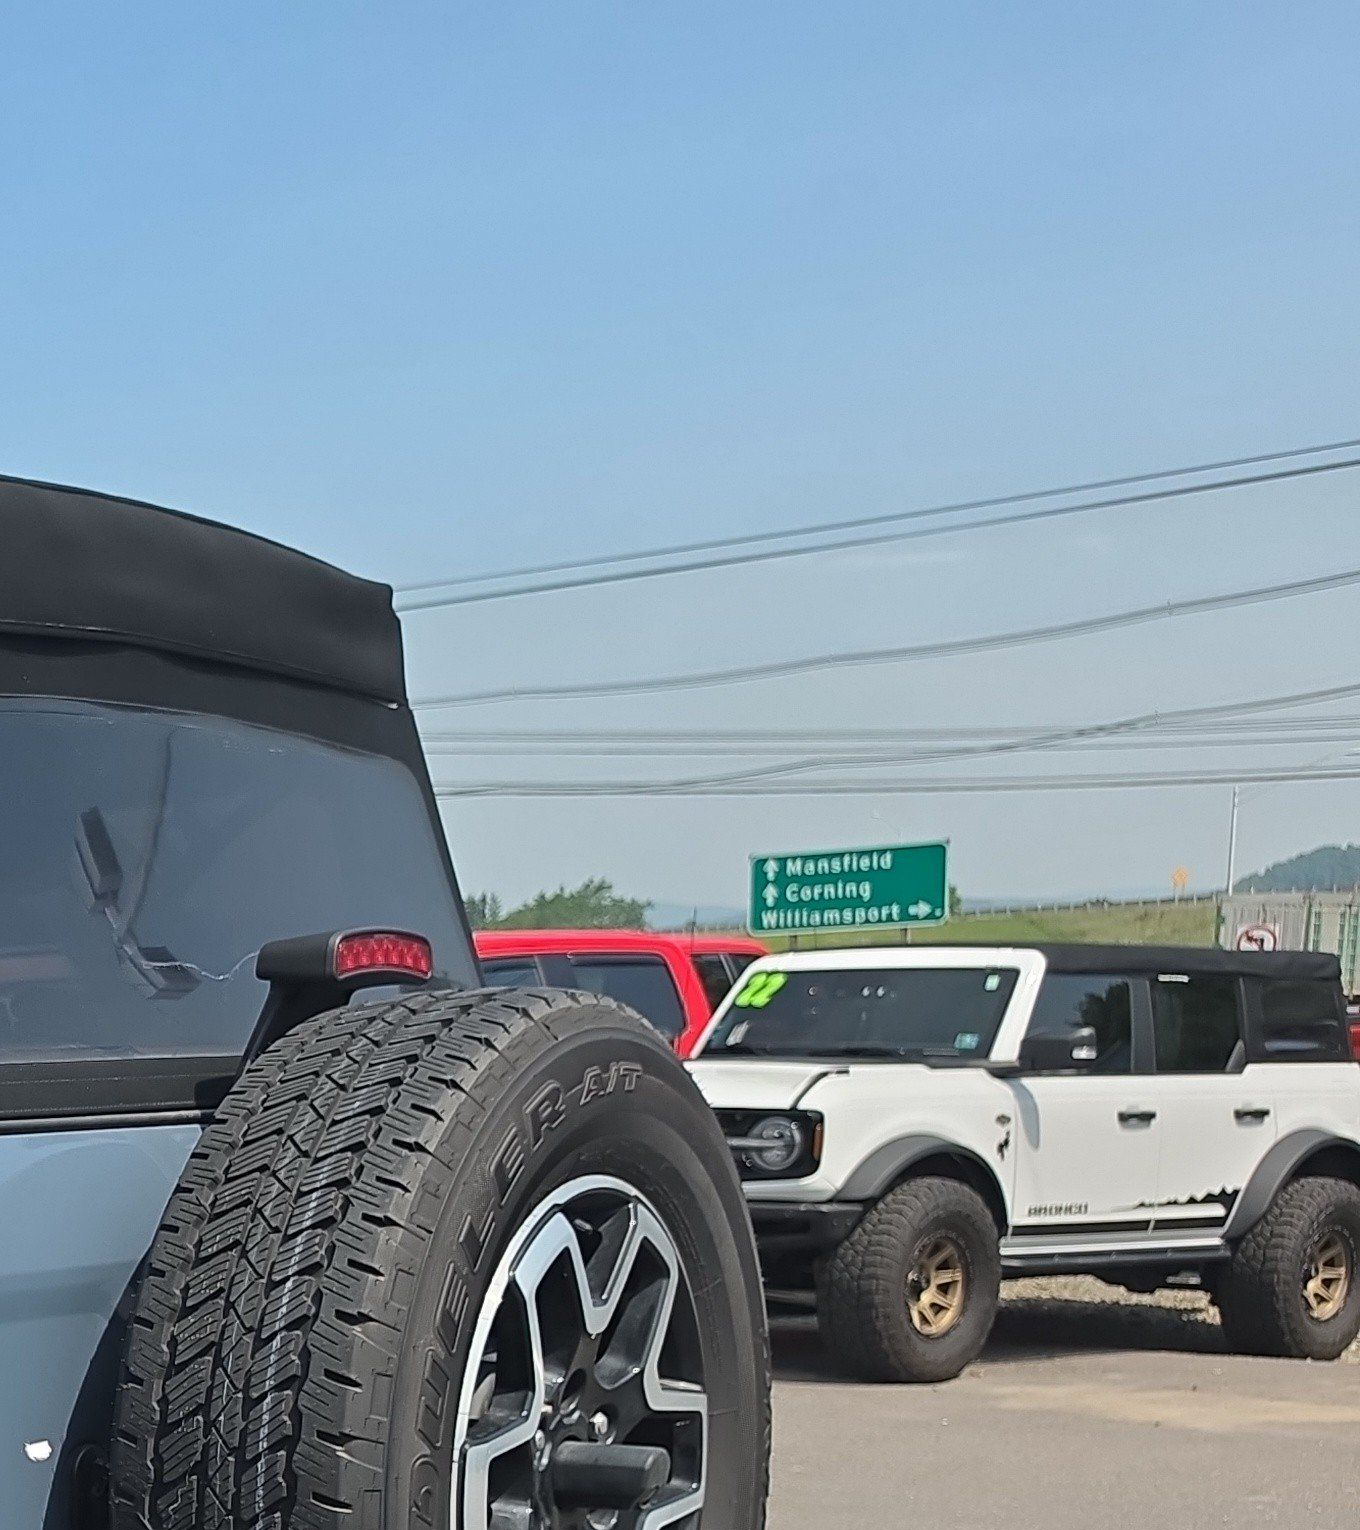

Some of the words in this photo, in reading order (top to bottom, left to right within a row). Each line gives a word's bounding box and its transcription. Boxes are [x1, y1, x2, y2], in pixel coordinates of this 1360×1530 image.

[785, 850, 893, 878] Mansfield
[785, 879, 872, 903] Corning
[761, 901, 901, 930] Williamsport
[734, 972, 788, 1008] 22
[579, 1059, 644, 1108] A/T
